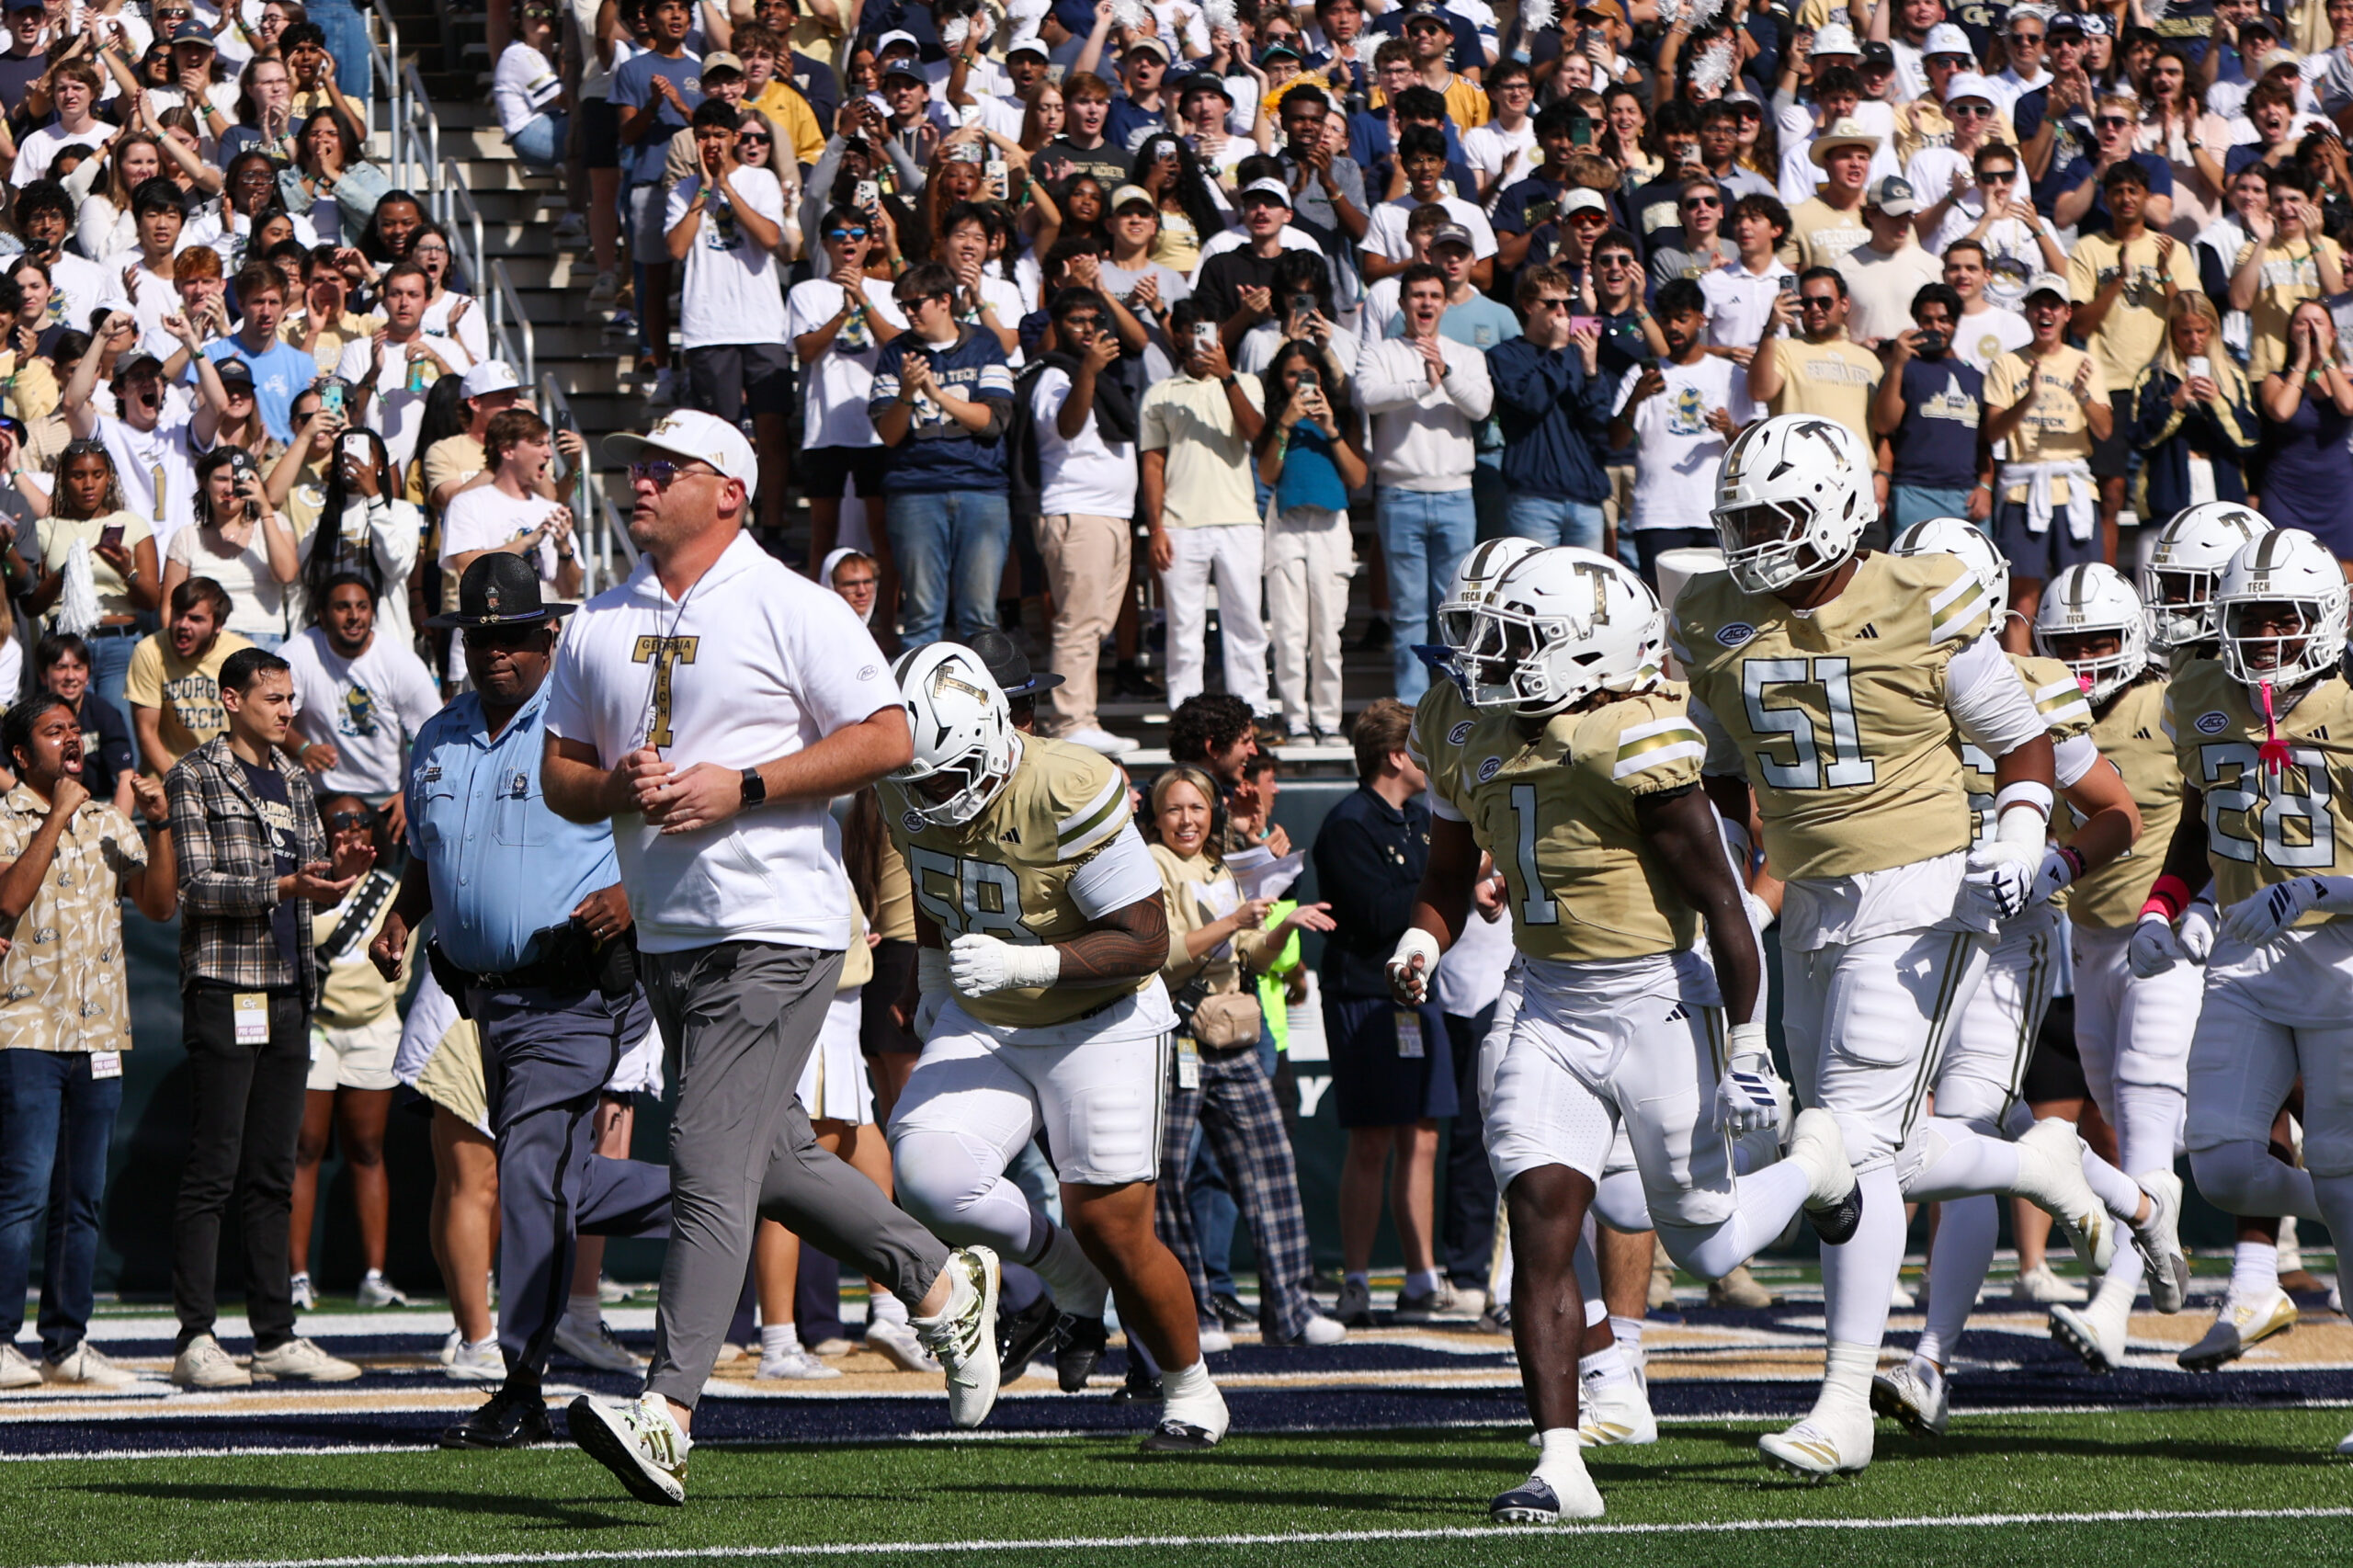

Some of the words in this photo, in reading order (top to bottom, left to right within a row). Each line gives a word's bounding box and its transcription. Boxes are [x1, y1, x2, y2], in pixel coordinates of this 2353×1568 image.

[947, 368, 969, 382] TECH
[2247, 582, 2271, 593] TECH
[1461, 591, 1482, 602] TECH
[2066, 614, 2086, 624] TECH
[1724, 626, 1748, 638] ACC
[642, 639, 690, 652] GEORGIA
[163, 676, 222, 700] GEORG
[658, 660, 668, 718] TECH
[175, 707, 223, 729] TECH
[1743, 656, 1876, 790] 51
[2203, 718, 2223, 728] ACC
[1482, 764, 1497, 775] ACC
[2199, 742, 2336, 869] 28
[905, 814, 923, 824] ACC
[1510, 783, 1560, 926] 1
[909, 843, 1044, 947] 58
